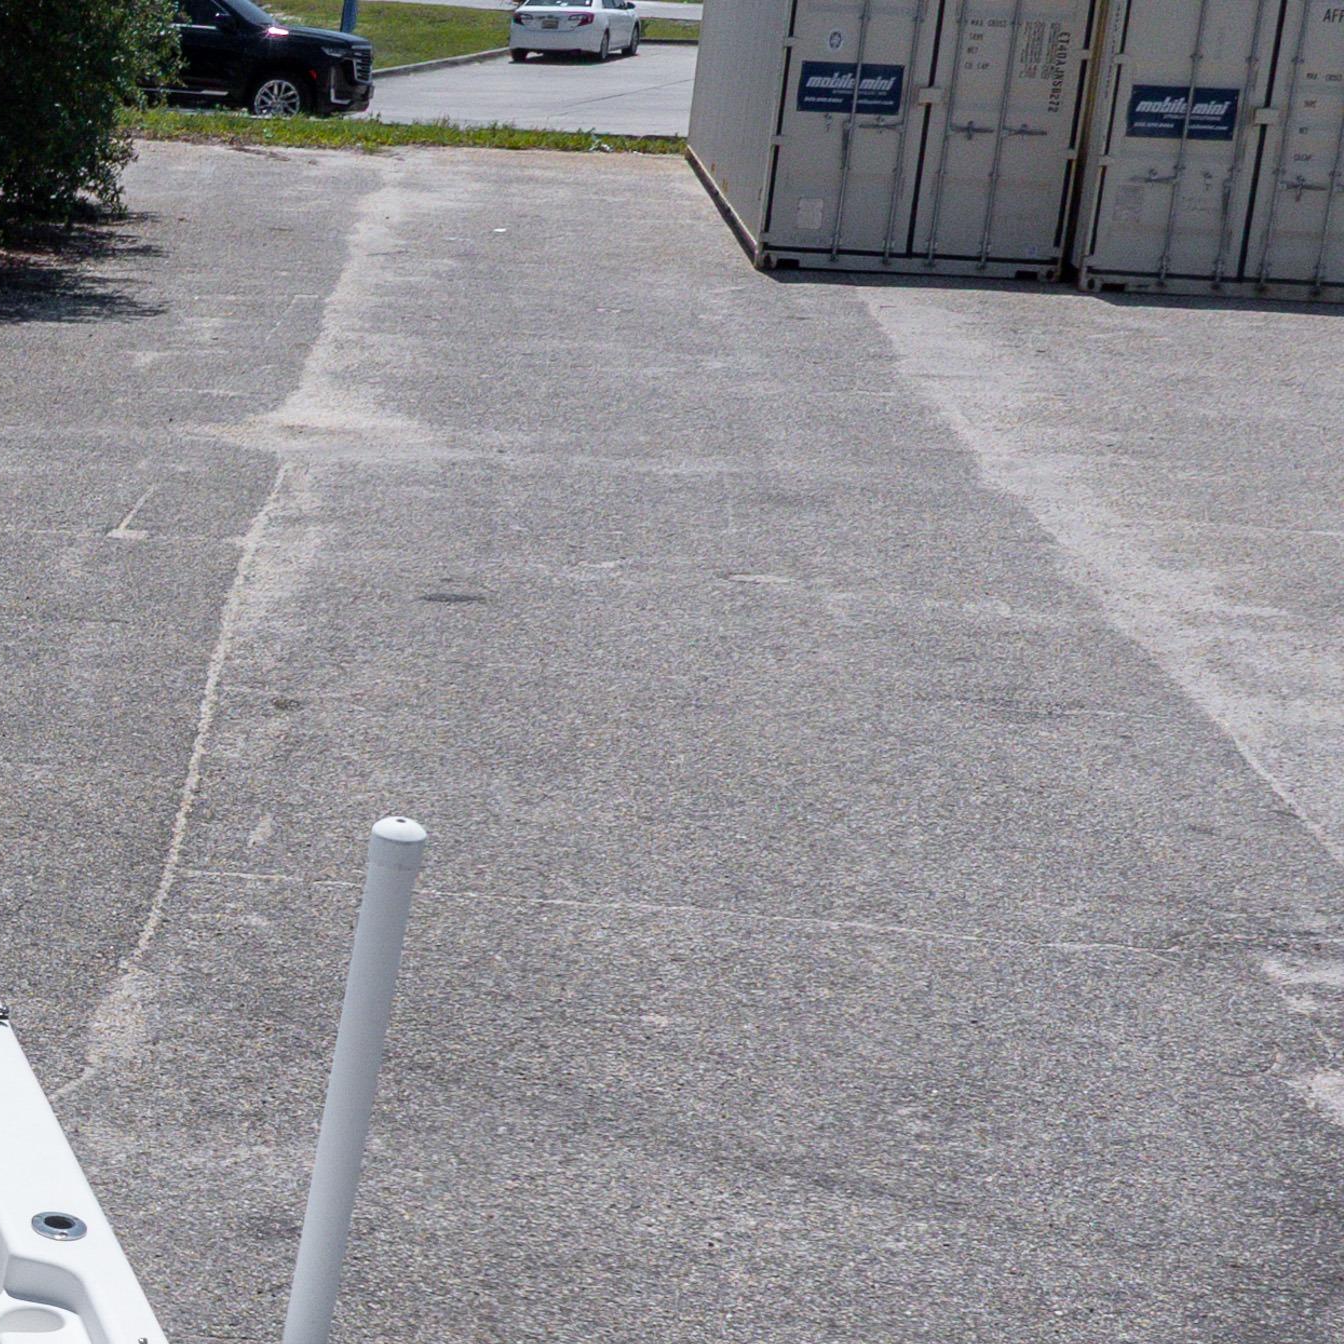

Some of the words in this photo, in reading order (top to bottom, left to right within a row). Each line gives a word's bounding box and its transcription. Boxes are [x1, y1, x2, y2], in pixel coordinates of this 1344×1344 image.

[806, 72, 856, 89] mobile
[859, 76, 897, 90] mini
[1136, 97, 1189, 113] mobile
[1192, 101, 1231, 115] mini
